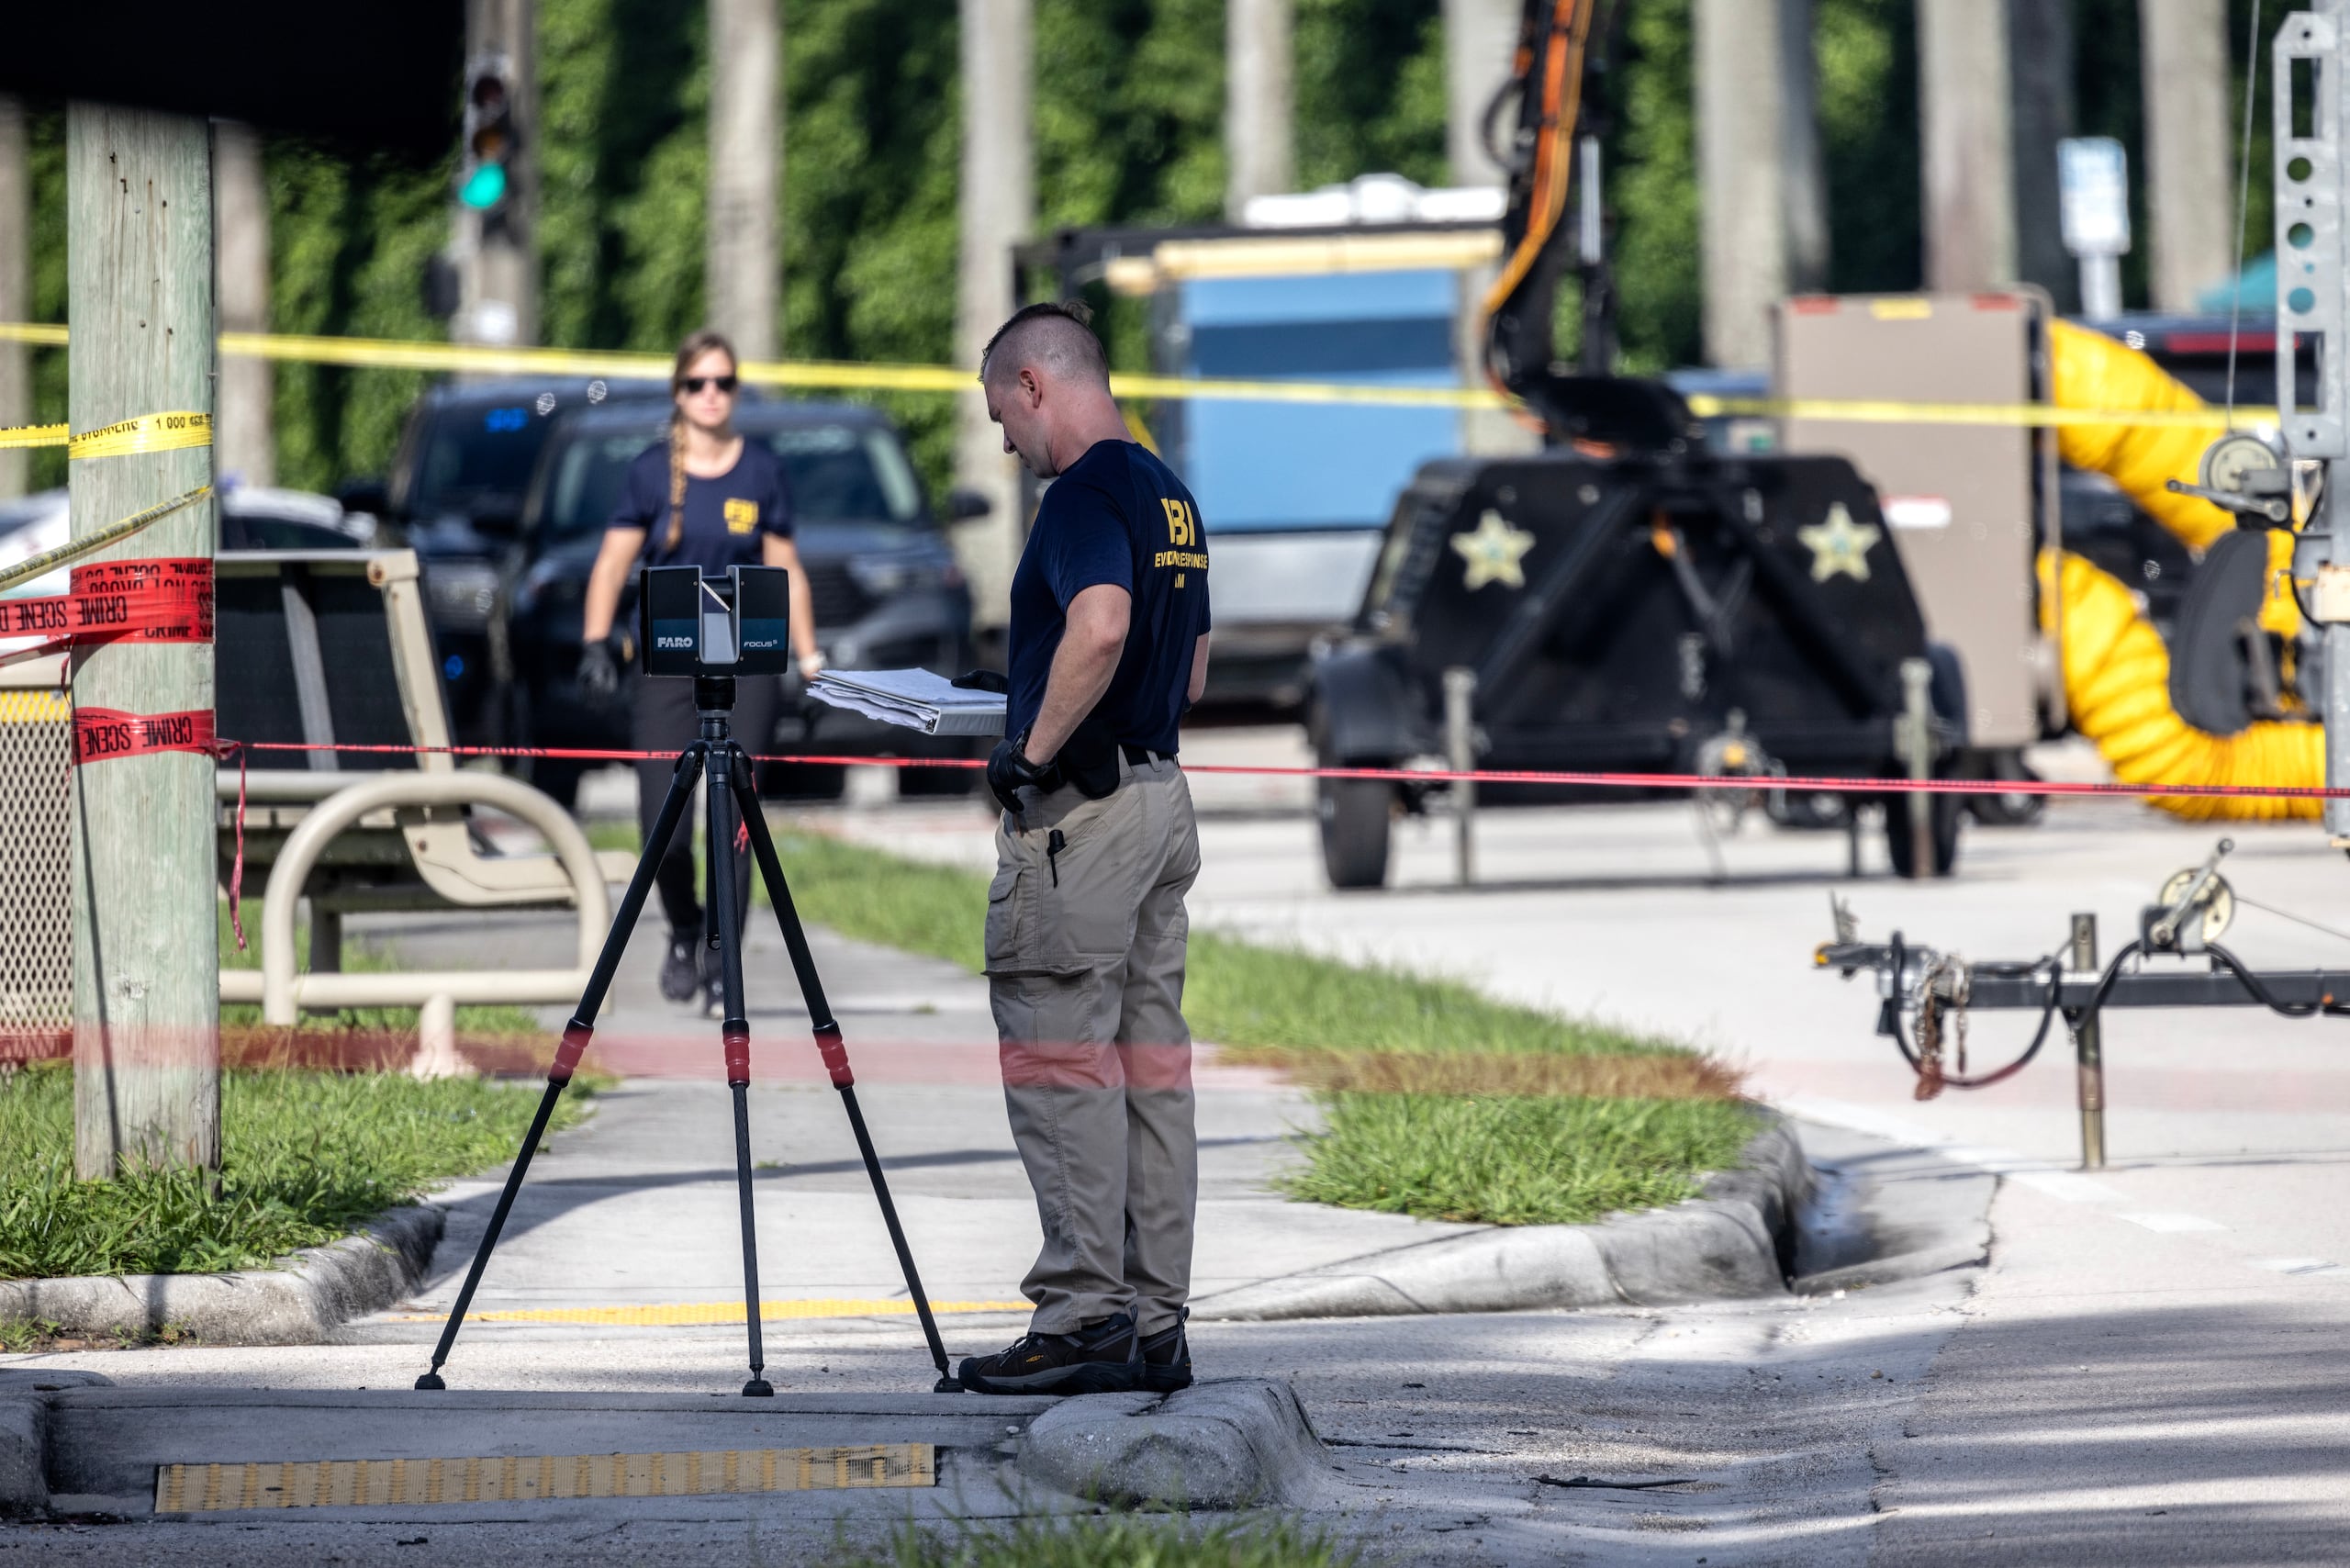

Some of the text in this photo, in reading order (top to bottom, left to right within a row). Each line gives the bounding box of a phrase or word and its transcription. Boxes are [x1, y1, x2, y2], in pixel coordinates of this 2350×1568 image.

[15, 600, 67, 632] SCENE
[75, 595, 128, 626] CRIME
[657, 636, 693, 647] FARO
[84, 723, 131, 756] SCENE
[140, 717, 193, 747] CRIME
